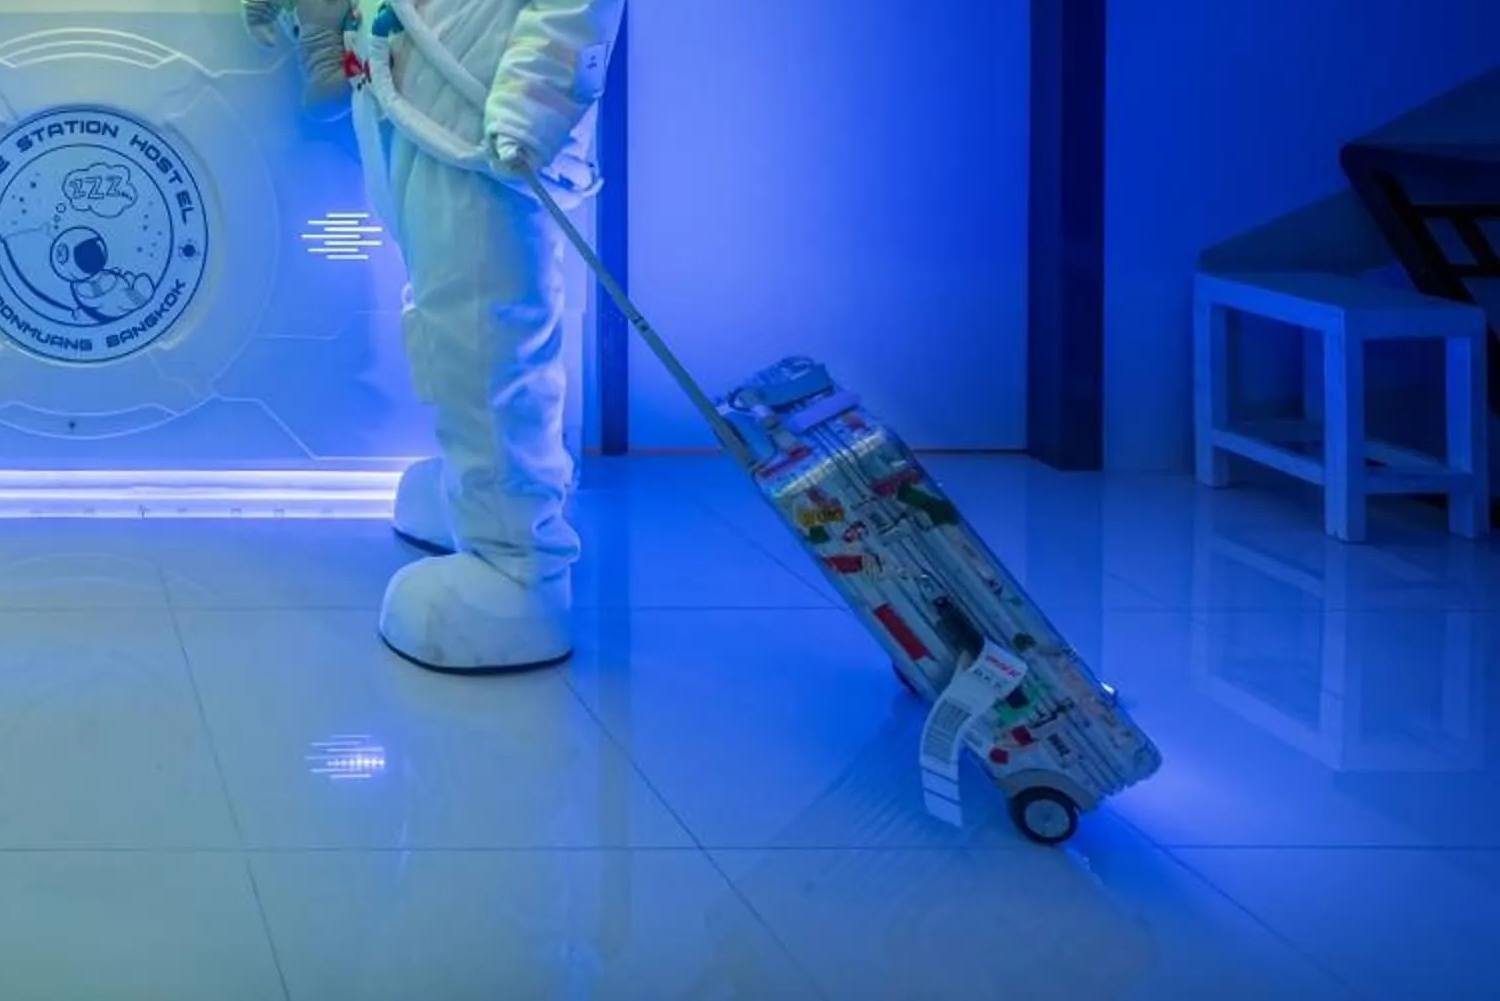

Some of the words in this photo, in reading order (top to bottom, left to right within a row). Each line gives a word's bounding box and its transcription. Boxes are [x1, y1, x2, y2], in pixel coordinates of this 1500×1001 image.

[16, 119, 119, 153] STATION
[129, 134, 195, 226] HOSTEL
[105, 278, 186, 348] BANGKOK
